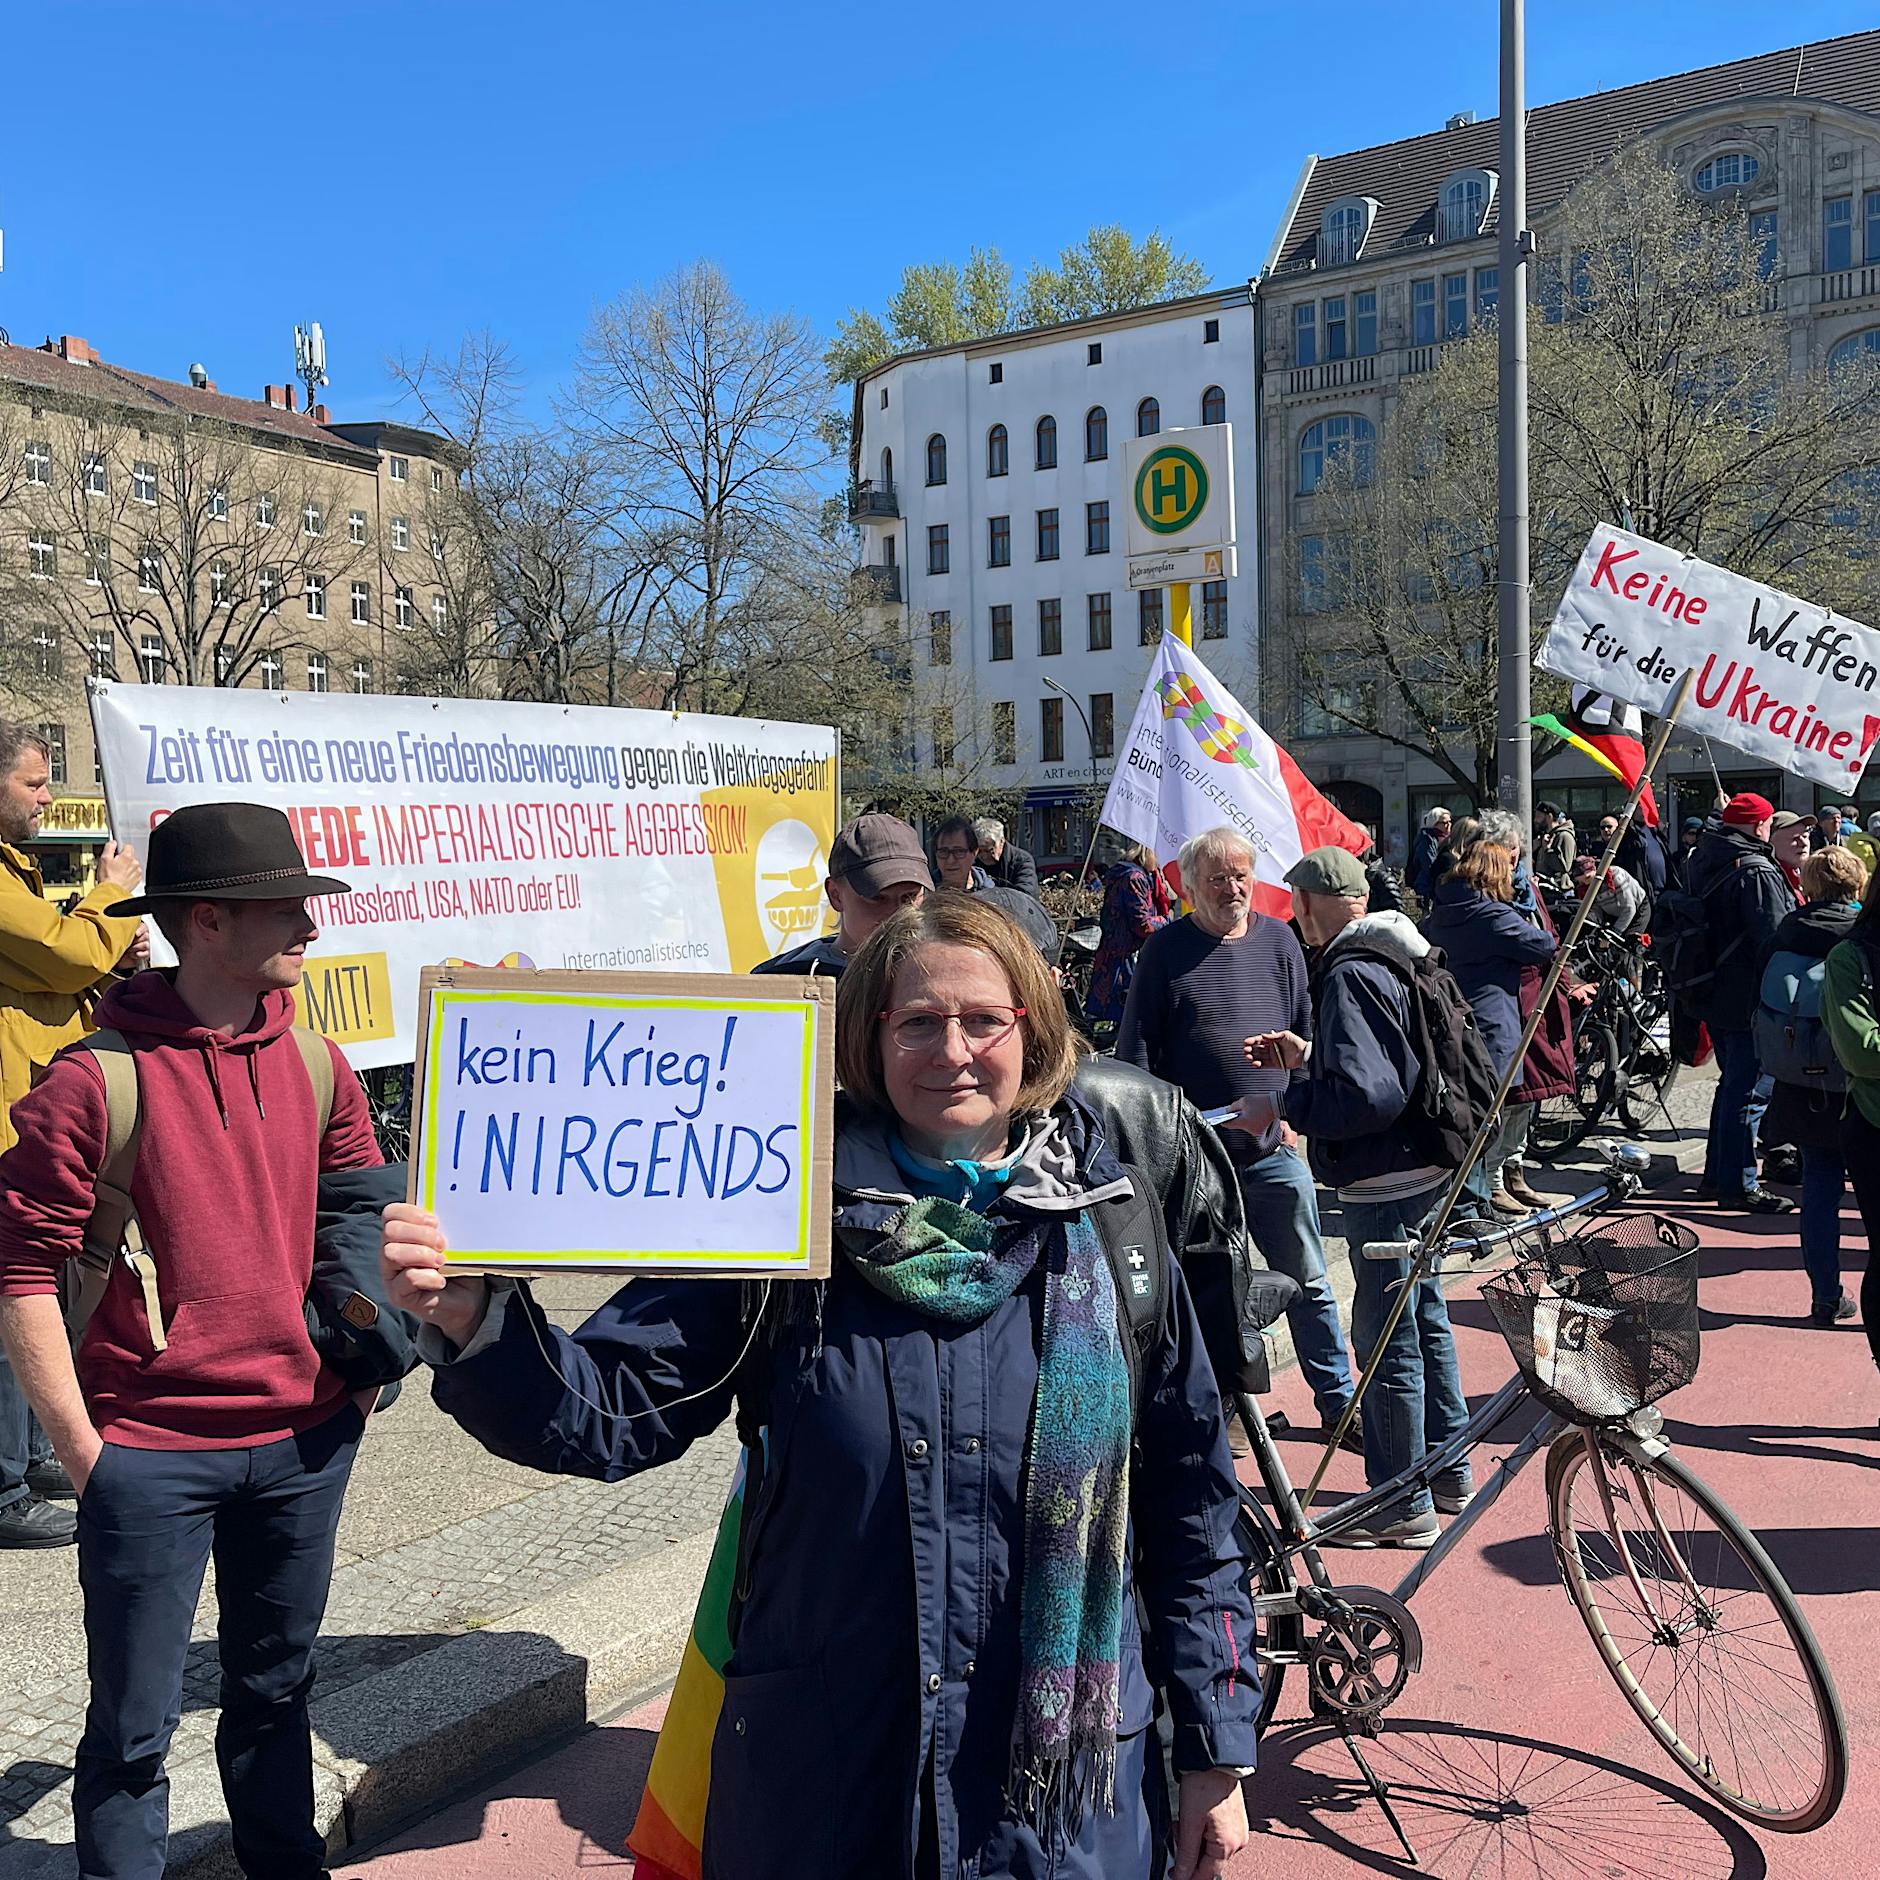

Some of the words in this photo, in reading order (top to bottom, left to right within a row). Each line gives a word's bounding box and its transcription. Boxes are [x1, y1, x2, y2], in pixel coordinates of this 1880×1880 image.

[1152, 464, 1187, 516] H
[1590, 541, 1708, 625] Keine
[1747, 597, 1878, 692] Waffen
[1581, 623, 1628, 664] für
[1636, 646, 1678, 684] die
[1694, 653, 1880, 773] Ukraine!
[139, 724, 203, 785] Zeit
[206, 725, 253, 784] für
[257, 730, 323, 784] eine
[324, 739, 397, 784] neue
[396, 729, 620, 790] Friedensbewegung
[620, 746, 682, 790] gegen
[681, 740, 709, 786] die
[707, 742, 830, 795] Weltkriegsgefahr!
[1042, 768, 1066, 780] ART
[1067, 768, 1080, 777] en
[371, 802, 620, 866] IMPERIALISTISCHE
[625, 802, 748, 857] AGGRESSION!
[327, 880, 425, 927] Russland,
[424, 879, 469, 920] USA,
[469, 876, 515, 917] NATO
[517, 874, 554, 914] oder
[554, 873, 582, 910] EU!
[562, 940, 710, 969] Internationalistisches
[302, 965, 374, 1035] MIT!
[457, 1016, 556, 1087] kein
[583, 1016, 738, 1120] Krieg!
